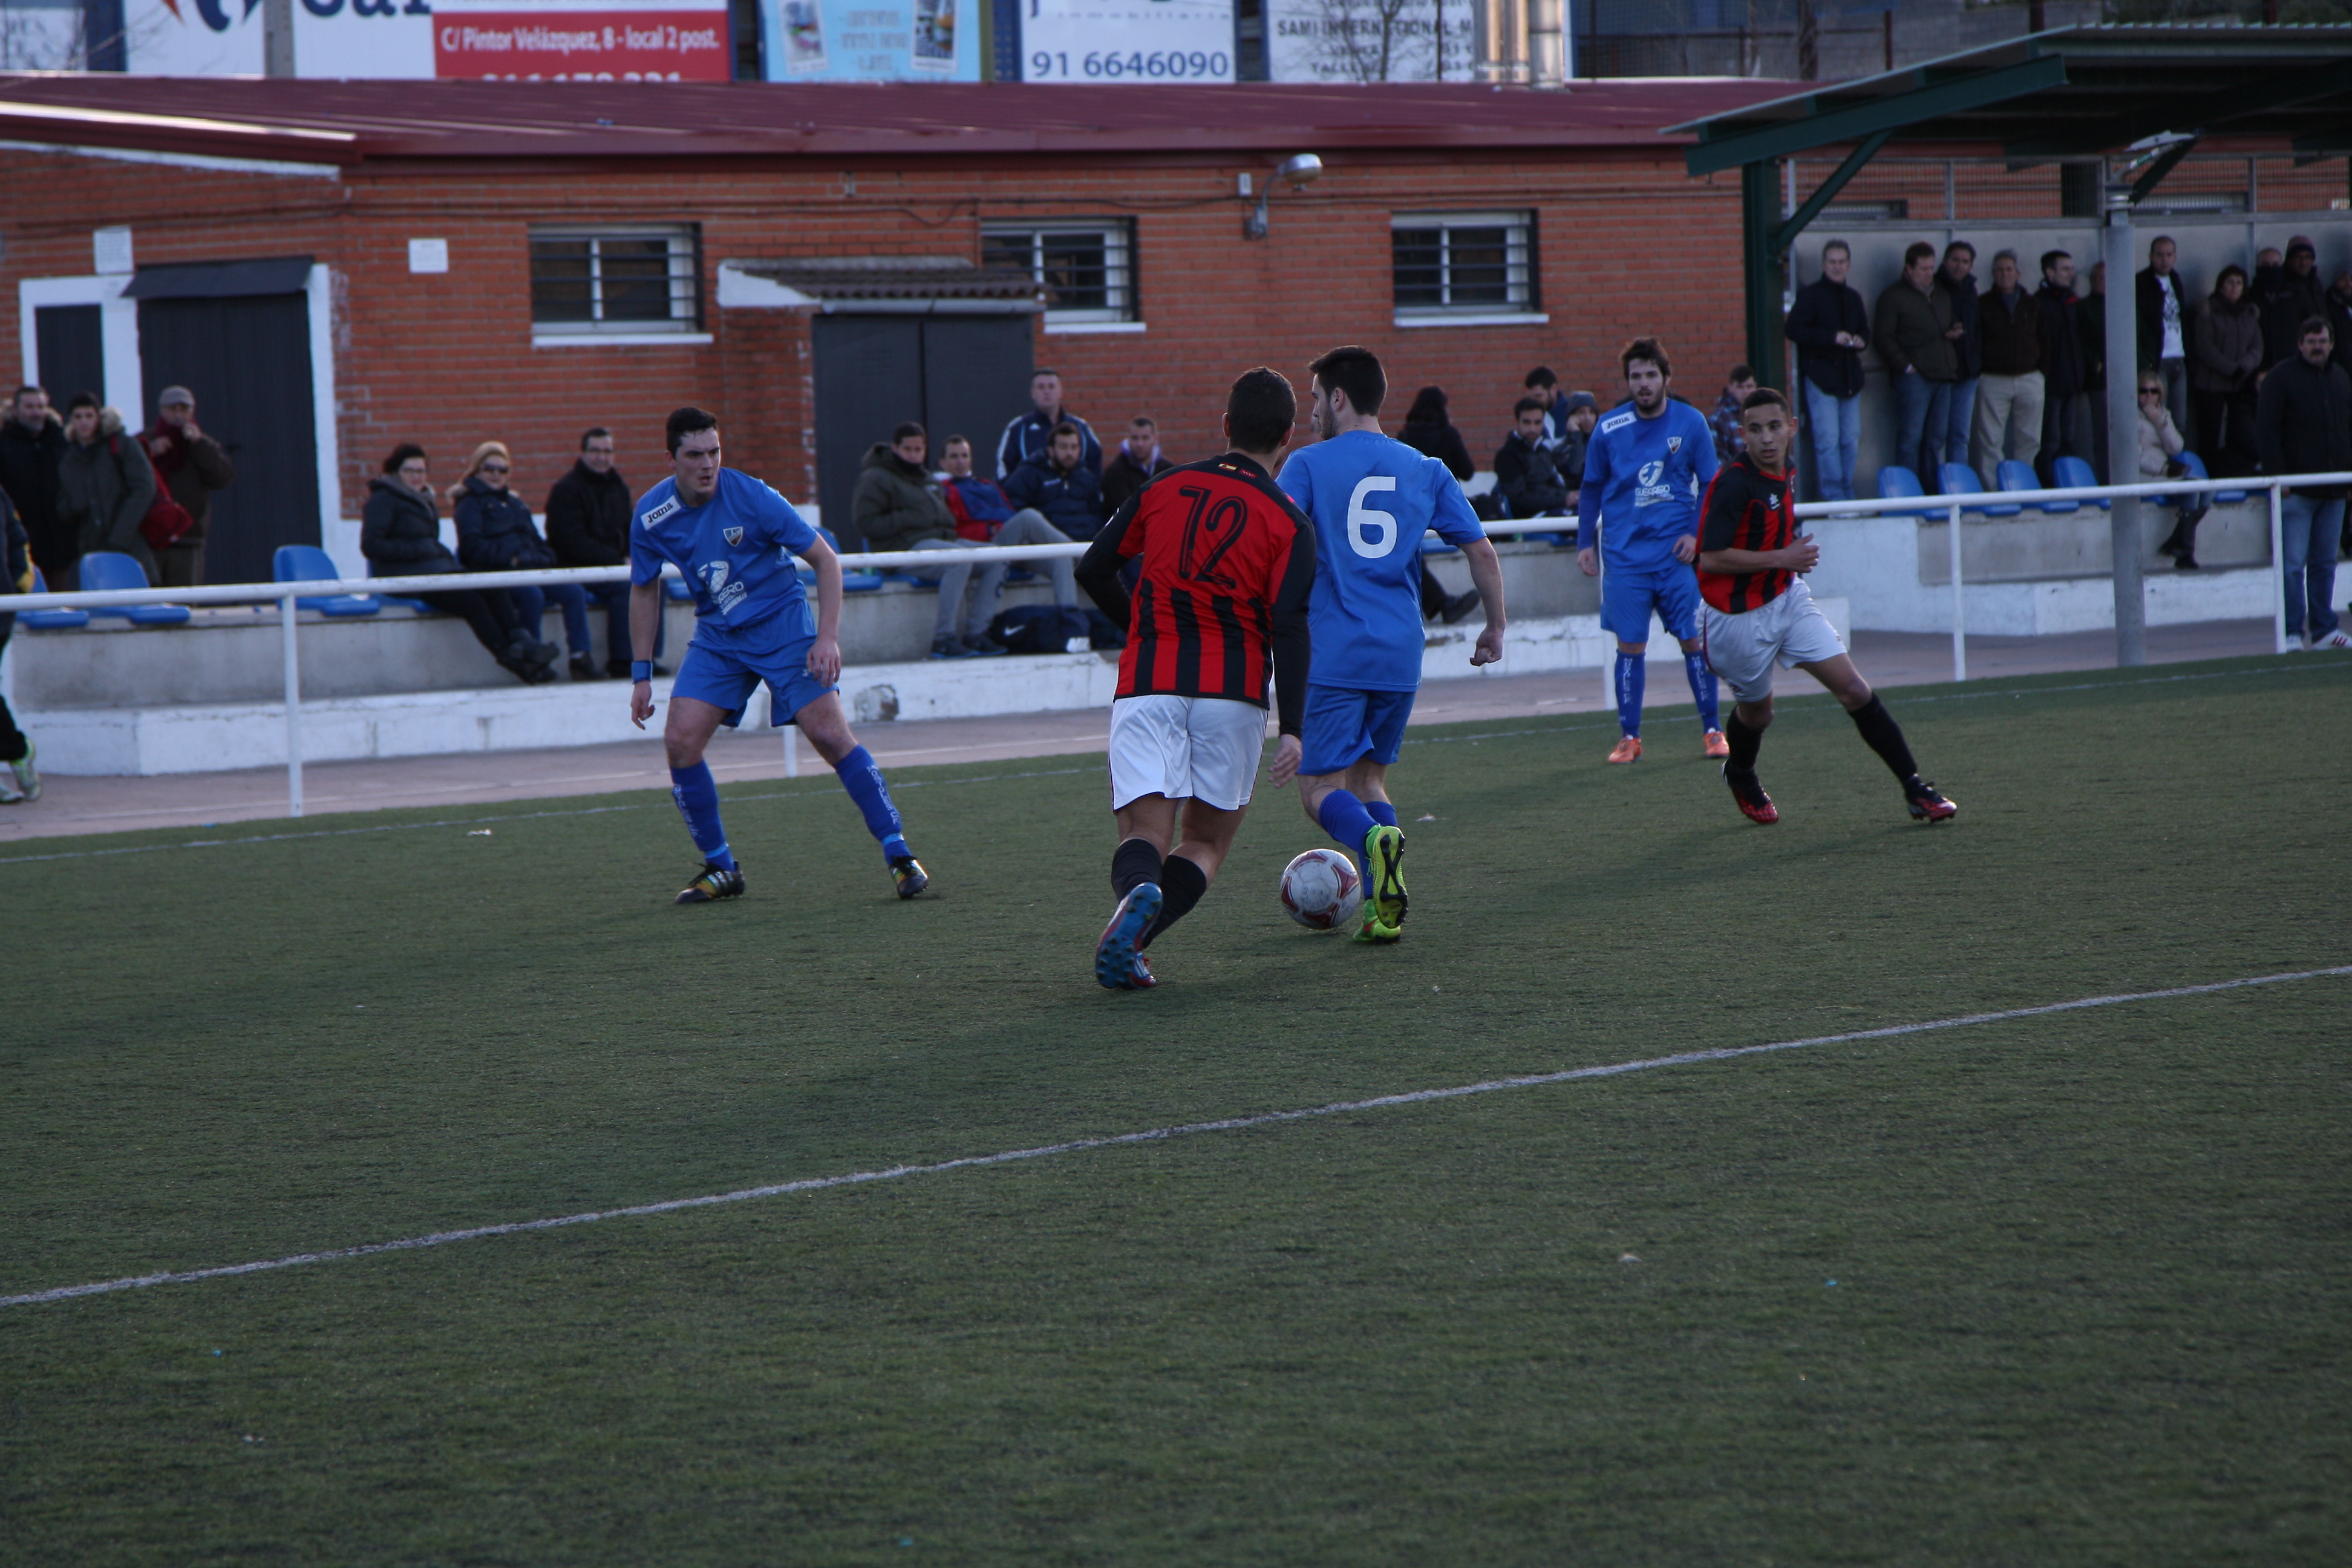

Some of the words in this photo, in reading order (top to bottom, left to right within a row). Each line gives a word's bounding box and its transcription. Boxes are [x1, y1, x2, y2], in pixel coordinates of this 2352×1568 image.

[441, 26, 461, 52] C/
[462, 26, 512, 51] Pintor
[625, 24, 664, 50] local
[667, 25, 678, 50] 2
[679, 28, 720, 54] post.
[1032, 51, 1068, 77] 91
[1083, 51, 1229, 77] 6646090
[1179, 485, 1247, 590] 12
[1347, 476, 1398, 559] 6
